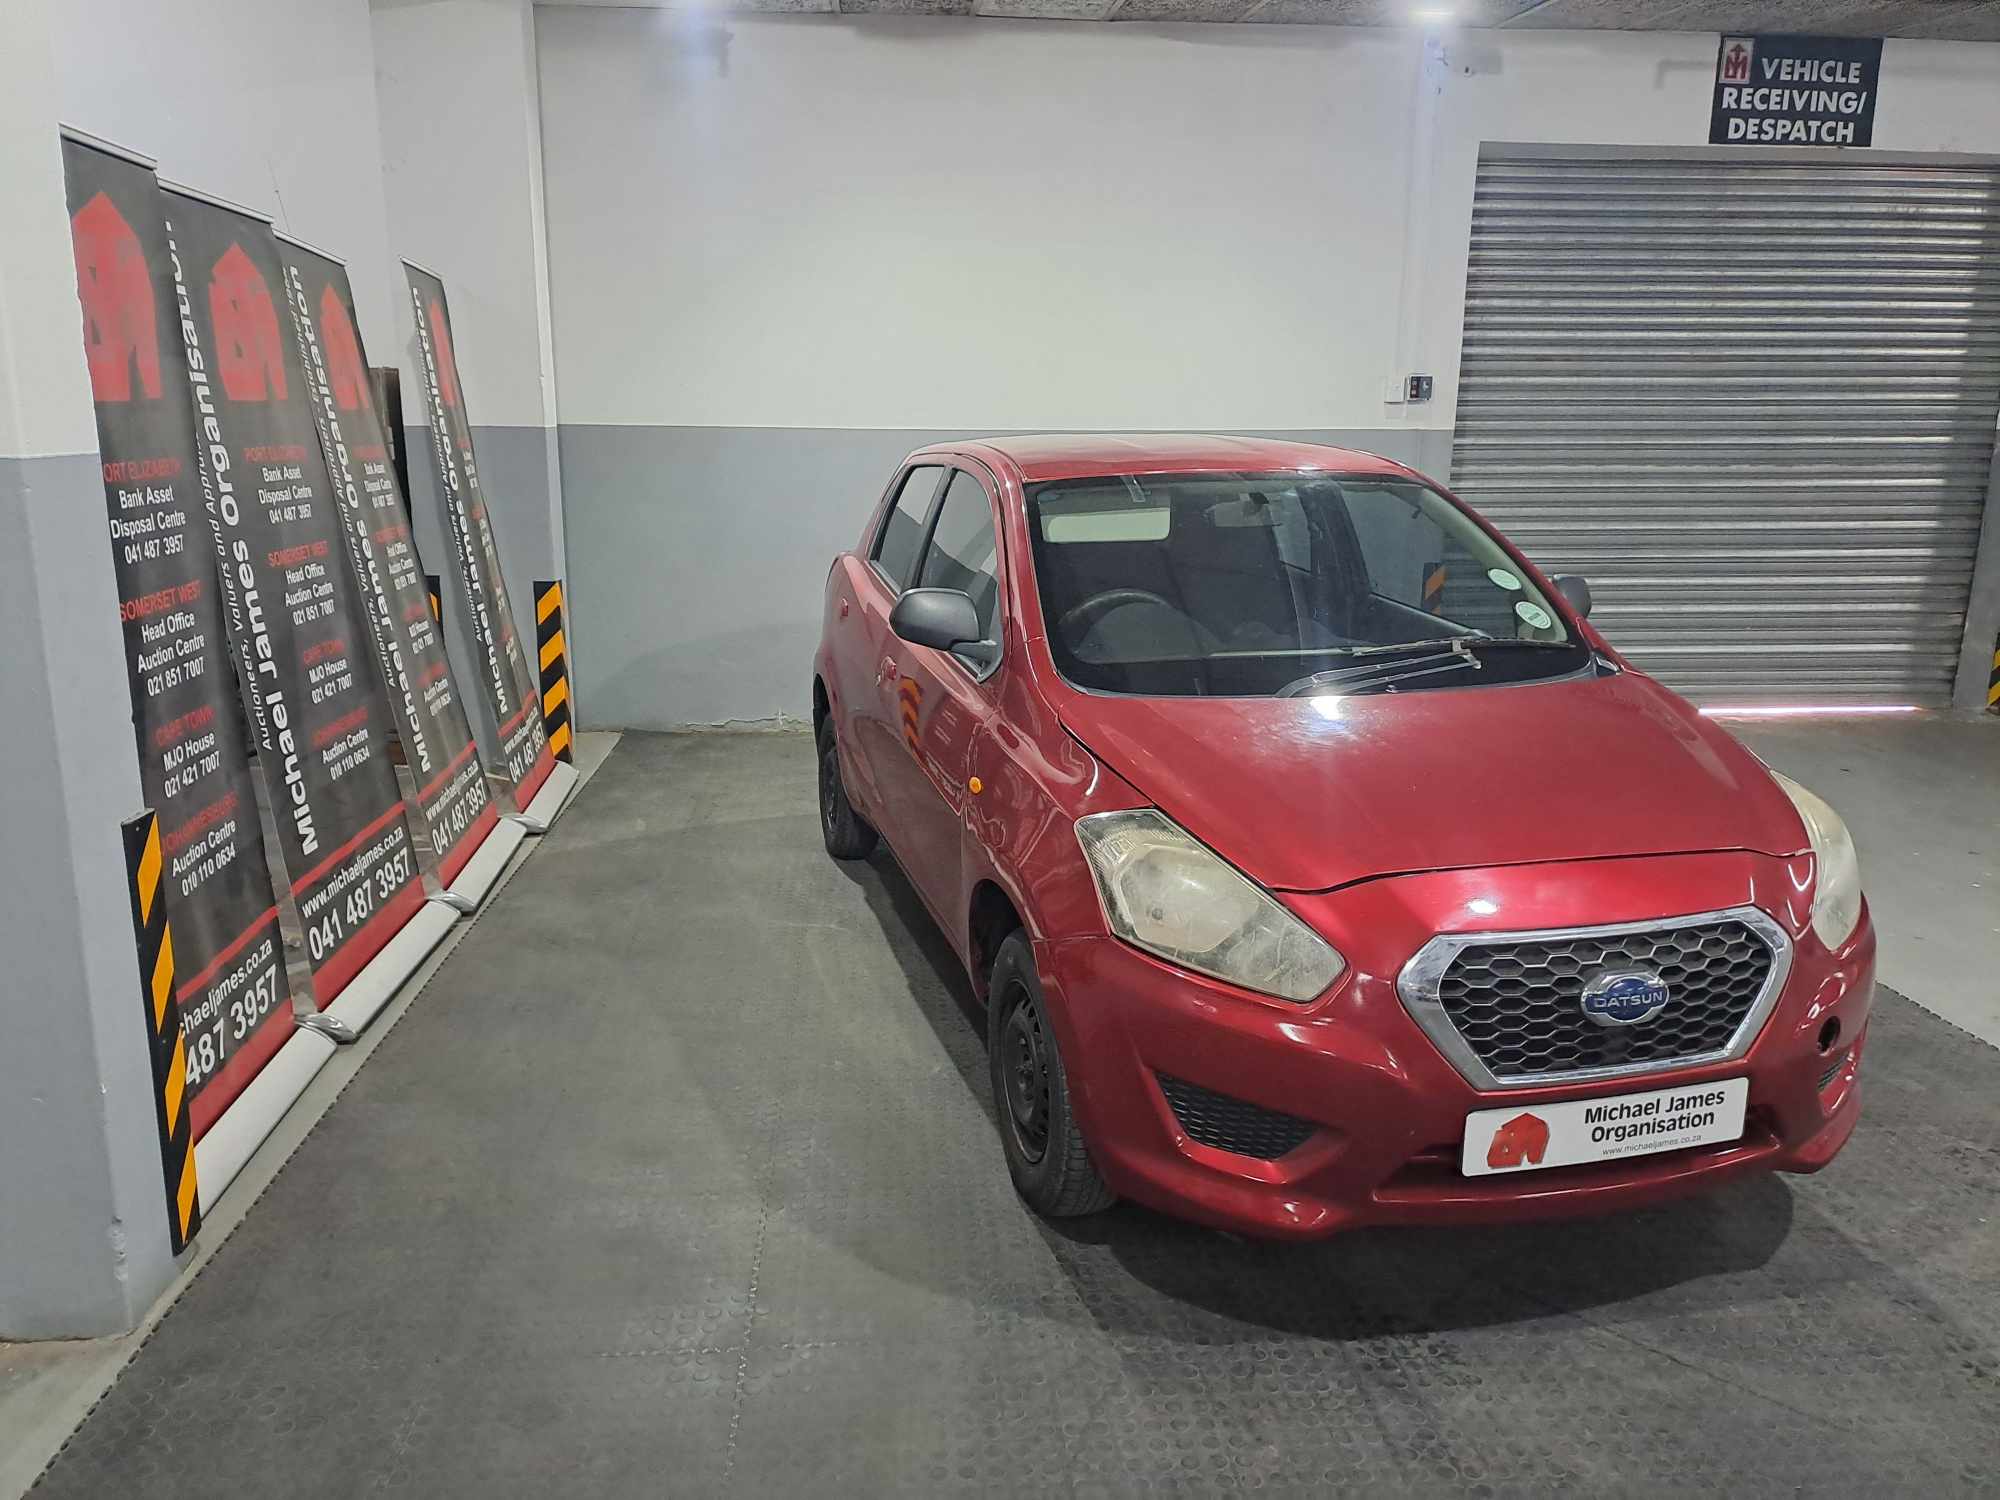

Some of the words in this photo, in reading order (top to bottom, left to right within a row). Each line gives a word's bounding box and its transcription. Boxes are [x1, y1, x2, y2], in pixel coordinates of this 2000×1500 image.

[1762, 57, 1862, 83] VEHICLE
[1722, 87, 1867, 114] RECEIVING/
[1727, 118, 1855, 143] DESPATCH
[289, 265, 359, 509] Organisation
[412, 287, 459, 491] Organisation
[103, 461, 127, 482] ORT
[262, 466, 282, 482] Bank
[319, 417, 344, 500] Appraisers
[119, 487, 145, 509] Bank
[147, 484, 174, 505] Asset
[258, 487, 291, 505] Disposal
[292, 485, 312, 499] Centre
[110, 512, 156, 539] Disposal
[157, 509, 186, 529] Centre
[269, 509, 283, 525] 041
[284, 506, 296, 521] 487
[342, 503, 353, 532] and
[124, 542, 143, 565] 041
[144, 538, 162, 560] 487
[164, 534, 184, 555] 3957
[209, 520, 226, 556] and
[455, 499, 482, 595] James
[285, 567, 304, 585] Head
[304, 562, 325, 579] Office
[350, 536, 369, 592] Valuers
[356, 519, 394, 632] James
[121, 587, 176, 622] SOMERSET
[221, 562, 244, 631] Valuers
[232, 539, 278, 680] James
[285, 588, 312, 607] Auction
[312, 581, 334, 598] Centre
[142, 621, 166, 644] Head
[167, 611, 195, 636] Office
[293, 609, 306, 626] 021
[306, 603, 320, 620] 851
[138, 643, 175, 673] Auction
[176, 632, 205, 657] Centre
[368, 597, 396, 687] Auctioneers,
[476, 603, 508, 715] Michael
[147, 676, 165, 697] 021
[166, 665, 183, 687] 851
[184, 656, 205, 679] 7007
[309, 665, 325, 684] MJO
[325, 658, 347, 674] House
[311, 688, 324, 704] 021
[324, 682, 337, 698] 421
[337, 673, 353, 691] 7007
[241, 638, 272, 750] Auctioneers,
[388, 641, 431, 773] Michael
[163, 745, 184, 772] MJO
[185, 732, 215, 755] House
[322, 739, 347, 764] Auction
[347, 728, 369, 748] Centre
[330, 764, 342, 781] 010
[342, 755, 354, 772] 110
[354, 745, 371, 765] 0634
[164, 776, 181, 798] 021
[182, 763, 198, 785] 421
[199, 751, 221, 776] 7007
[266, 691, 319, 856] Michael
[509, 755, 525, 784] 041
[432, 817, 453, 856] 041
[452, 799, 470, 834] 487
[469, 776, 488, 815] 3957
[172, 837, 207, 877] Auction
[208, 820, 236, 850] Centre
[181, 872, 198, 897] 010
[199, 858, 214, 881] 110
[215, 841, 236, 869] 0634
[301, 826, 404, 919] www.michaeljames.co.za
[308, 907, 344, 960] 041
[345, 878, 374, 926] 487
[375, 846, 411, 899] 3957
[182, 938, 273, 1036] haeljames.co.za
[1594, 991, 1664, 1008] DATSUN
[186, 1017, 224, 1086] 487
[231, 963, 277, 1040] 3957
[1584, 1098, 1660, 1125] Michael
[1665, 1090, 1726, 1114] James
[1591, 1110, 1715, 1143] Organisation
[1602, 1134, 1702, 1157] www.michaeljames.co.za
